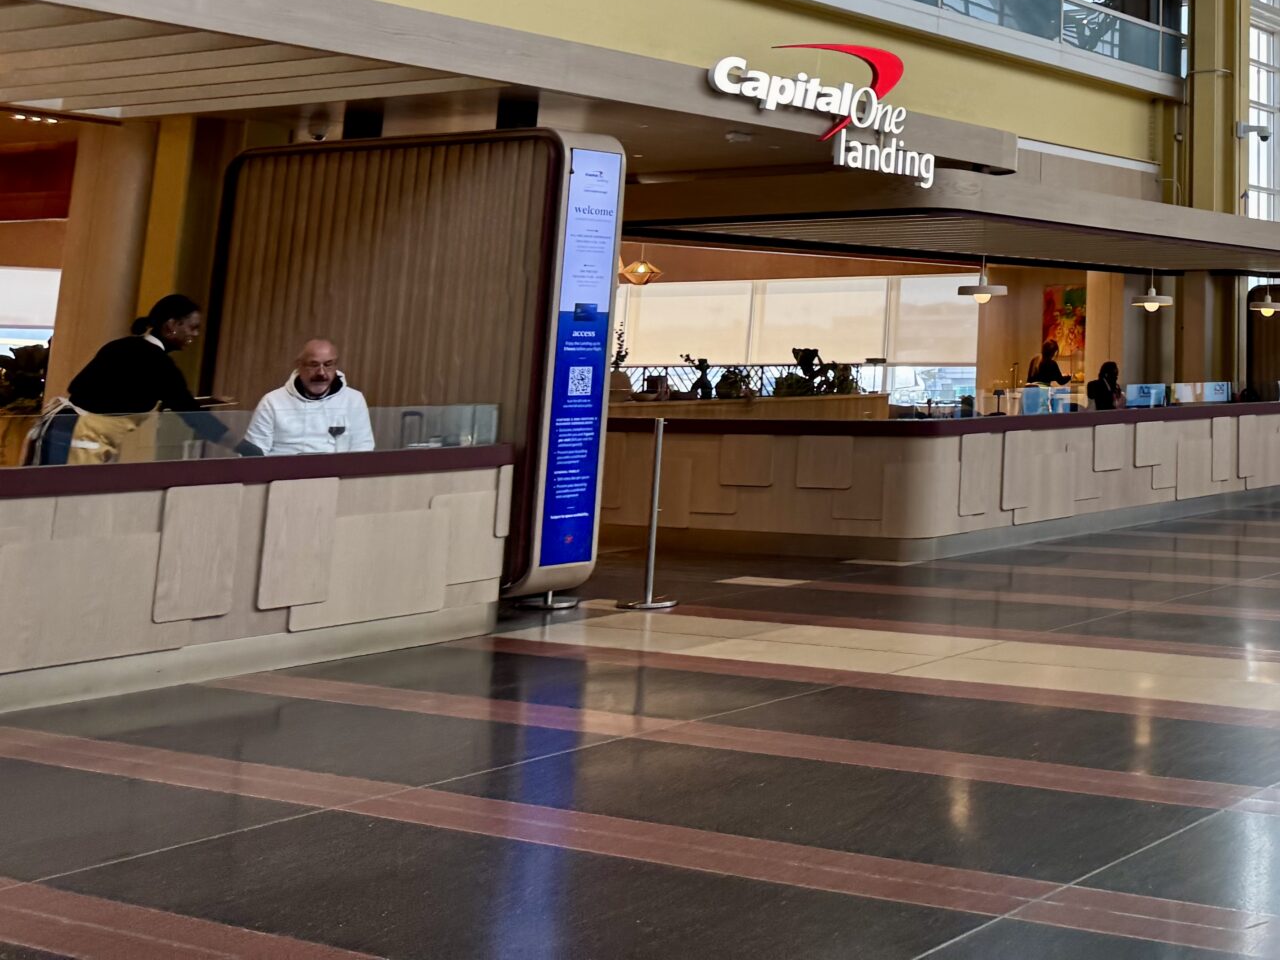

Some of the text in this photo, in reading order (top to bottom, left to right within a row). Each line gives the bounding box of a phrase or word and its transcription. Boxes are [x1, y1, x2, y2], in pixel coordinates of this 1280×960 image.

[709, 56, 906, 134] Capital One
[838, 129, 935, 189] landing
[574, 205, 614, 217] welcome
